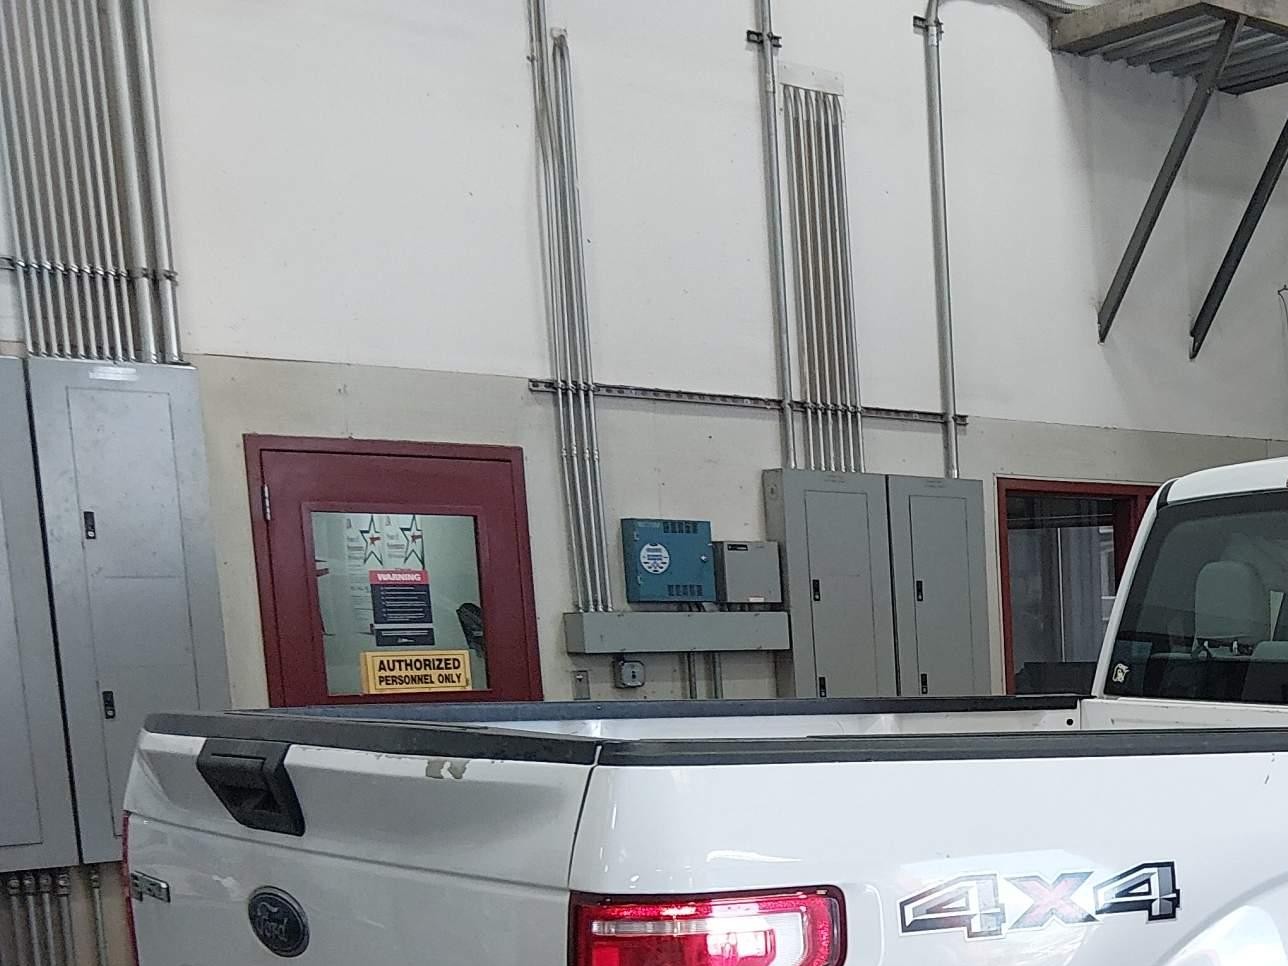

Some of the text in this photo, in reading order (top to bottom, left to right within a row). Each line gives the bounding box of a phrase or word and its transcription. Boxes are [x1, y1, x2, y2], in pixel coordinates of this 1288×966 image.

[376, 572, 422, 582] WARNING
[377, 657, 462, 673] AUTHORIZED
[378, 672, 462, 686] PERSONNEL ONLY
[256, 901, 289, 942] Ford
